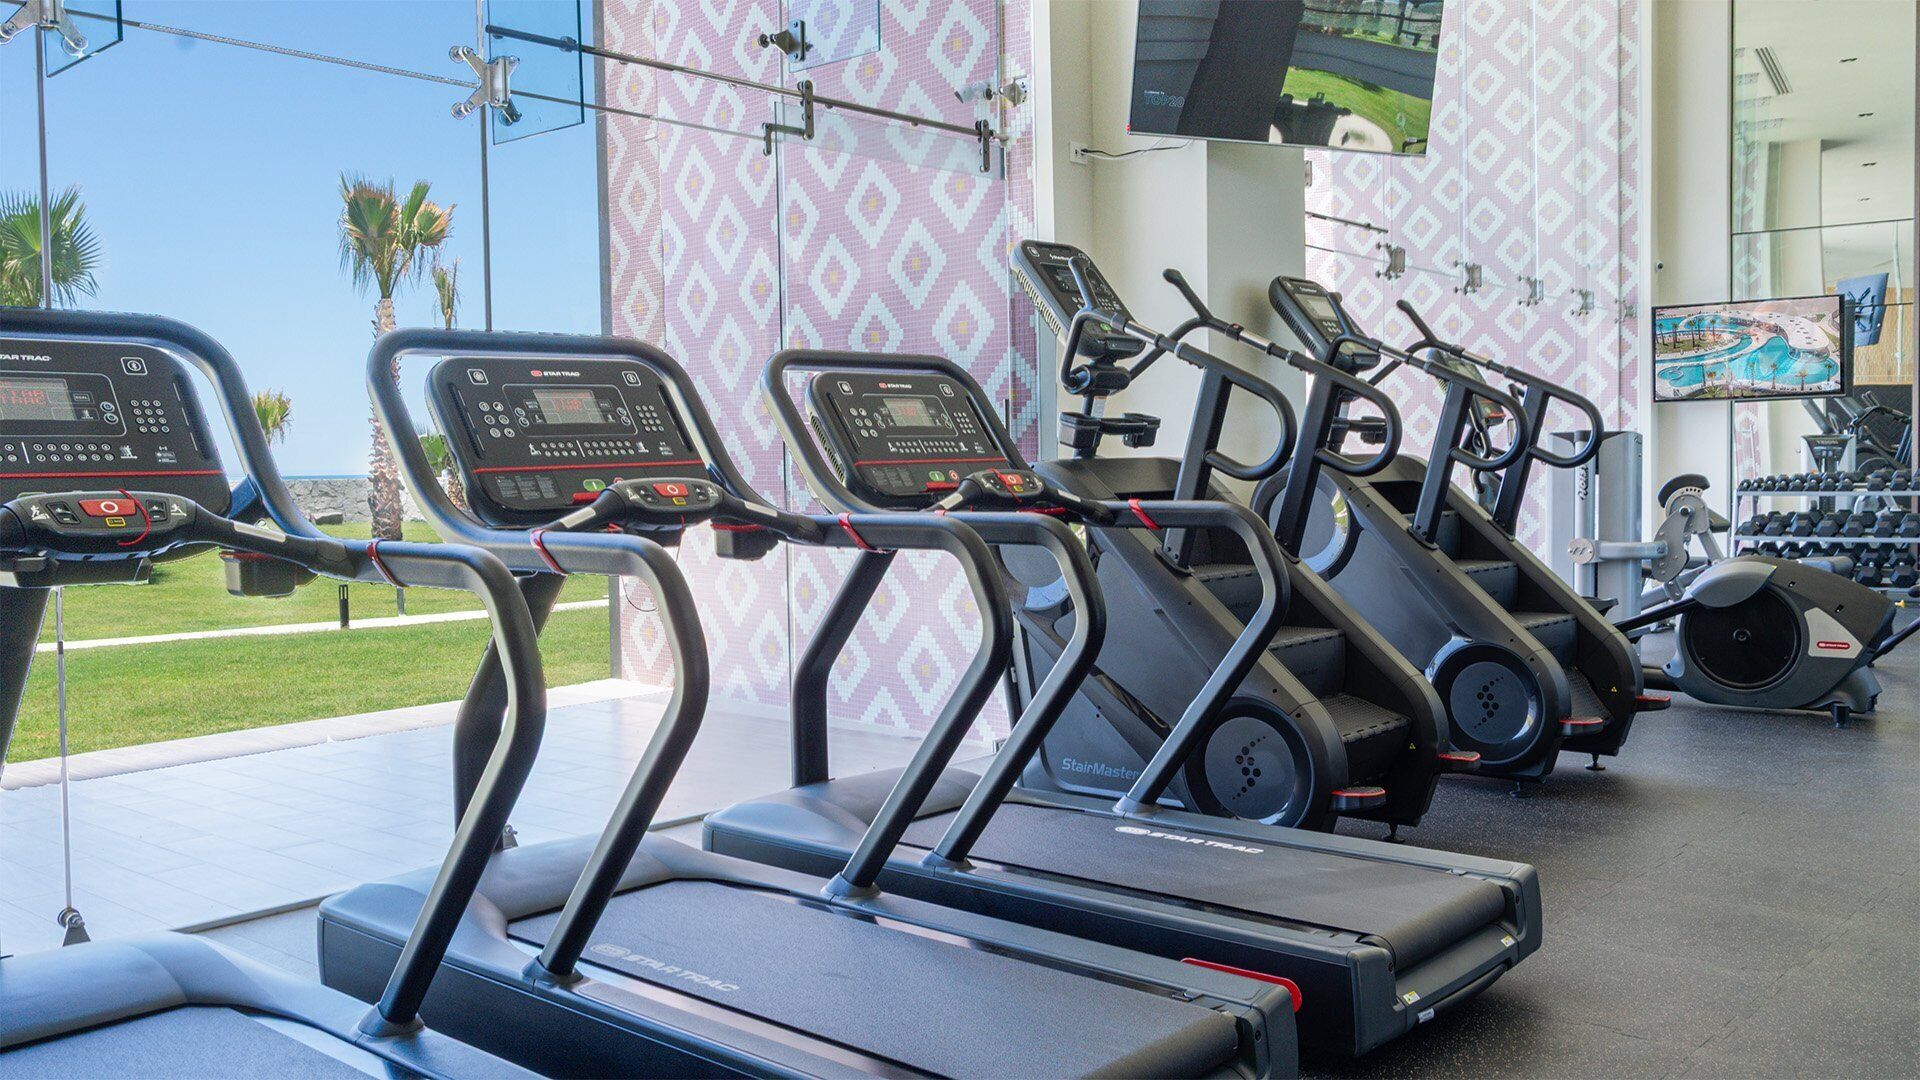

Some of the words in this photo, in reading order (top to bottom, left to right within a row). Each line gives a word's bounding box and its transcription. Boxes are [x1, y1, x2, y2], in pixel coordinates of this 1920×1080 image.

[1061, 758, 1140, 780] StairMaster
[1148, 832, 1205, 845] STAR
[1204, 840, 1264, 854] TRAC
[622, 954, 683, 974] STAR
[678, 969, 739, 992] TRAC
